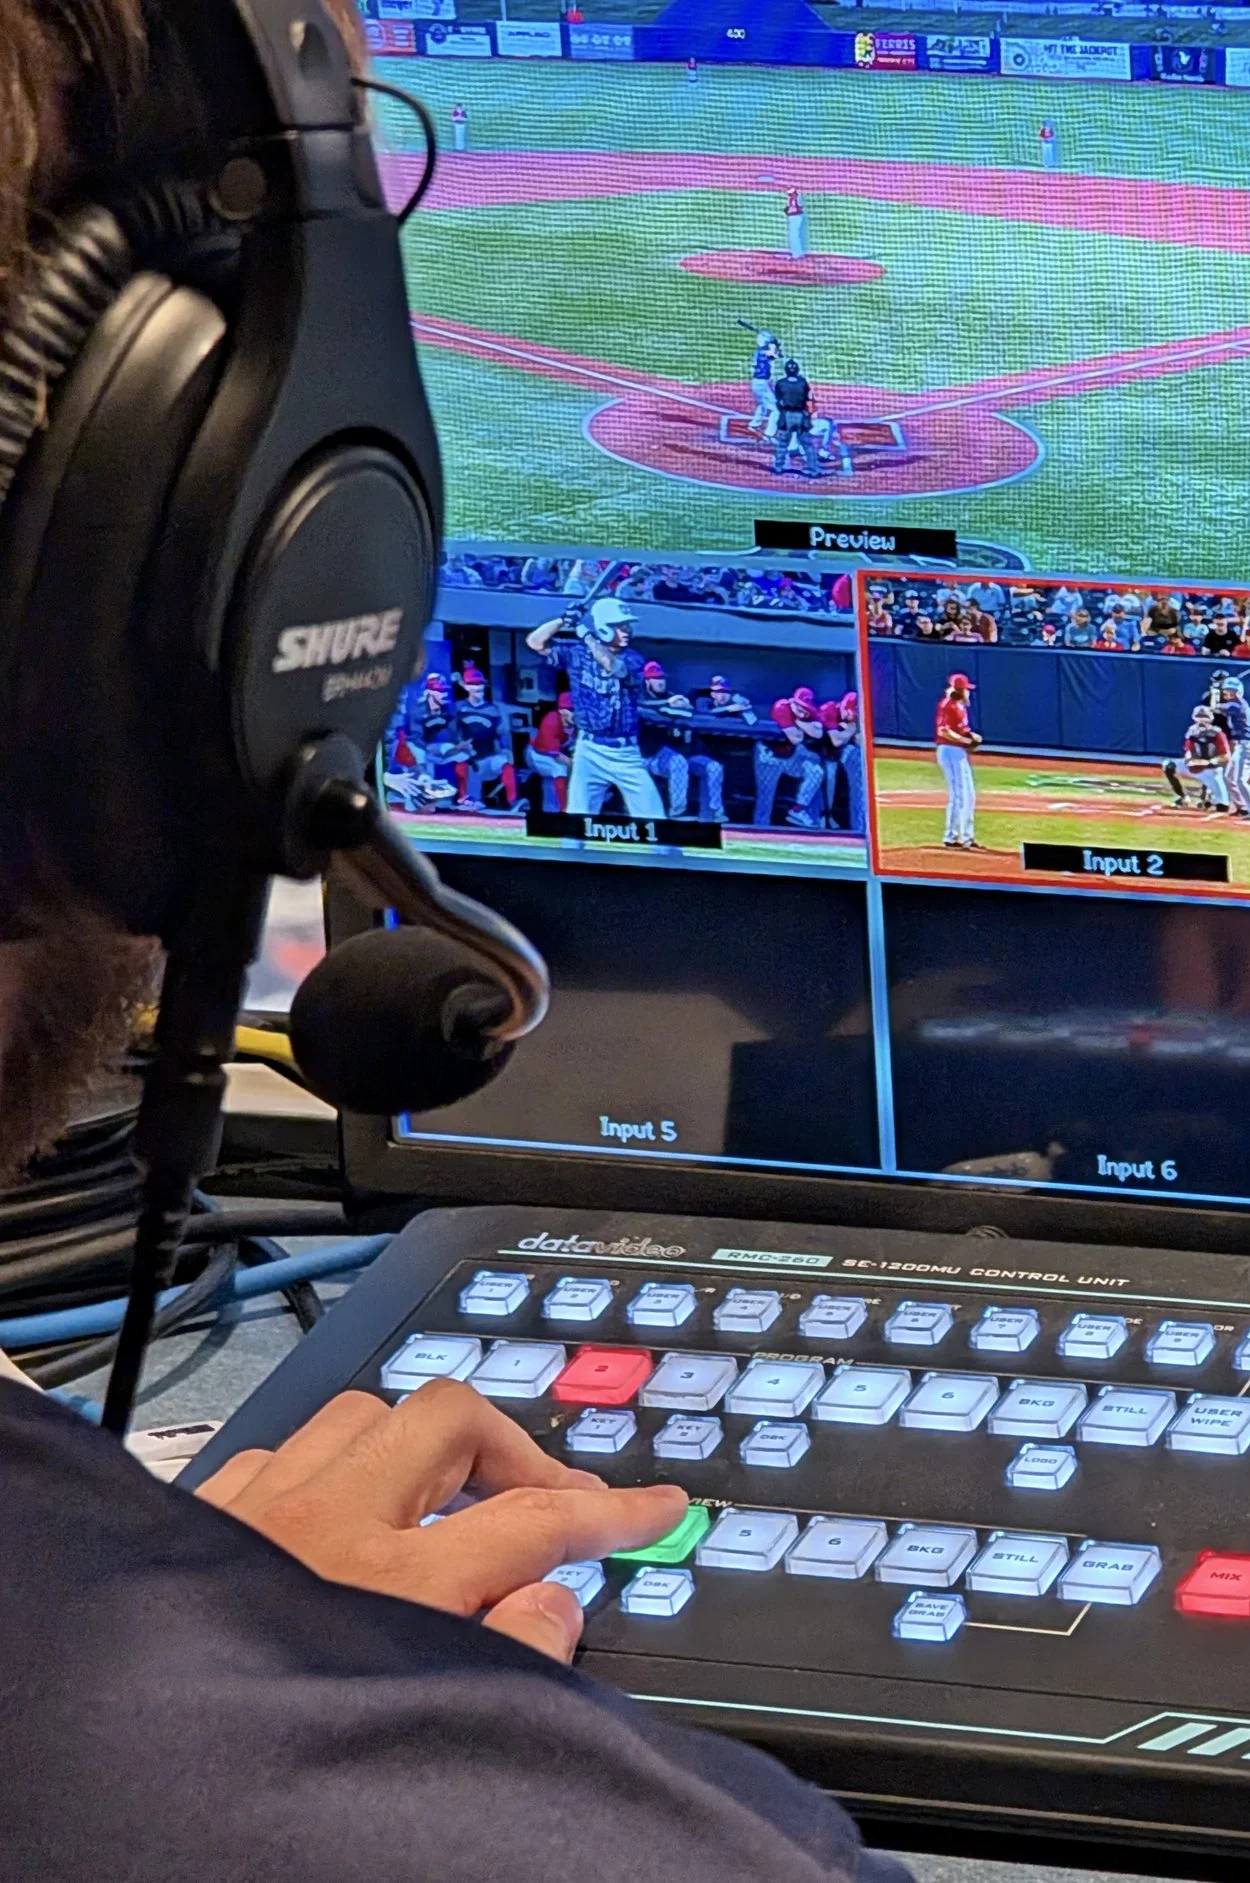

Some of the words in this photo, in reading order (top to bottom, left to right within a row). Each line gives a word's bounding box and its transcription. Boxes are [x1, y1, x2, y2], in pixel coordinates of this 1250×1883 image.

[809, 526, 896, 551] Preview
[272, 606, 404, 673] SHURE
[583, 817, 641, 844] Input
[645, 822, 658, 842] 1
[1082, 849, 1141, 877] Input
[1146, 854, 1165, 876] 2
[599, 1115, 656, 1143] Input
[661, 1121, 678, 1142] 5
[1097, 1153, 1156, 1182] Input
[1160, 1160, 1178, 1181] 6
[517, 1231, 687, 1258] datavideo
[726, 1249, 820, 1265] RMC-260
[841, 1258, 962, 1275] SE-1200MU
[969, 1266, 1071, 1283] CONTROL
[1077, 1275, 1131, 1287] UNIT
[414, 1351, 449, 1361] BLK
[751, 1352, 856, 1366] PROGRAM
[513, 1359, 522, 1367] 1
[679, 1371, 695, 1380] 3
[765, 1378, 781, 1386] 4
[853, 1384, 868, 1393] 5
[941, 1391, 955, 1400] 6
[1017, 1398, 1056, 1408] BKG
[1101, 1404, 1149, 1415] STILL
[590, 1416, 617, 1425] KEY
[1190, 1416, 1234, 1427] WIPE
[676, 1423, 703, 1432] KEY
[1023, 1456, 1059, 1465] LOGO
[828, 1537, 842, 1546] 6
[907, 1544, 945, 1555] BKG
[991, 1551, 1040, 1564] STILL
[1081, 1560, 1134, 1571] GRAB
[556, 1570, 585, 1578] KEY
[1209, 1570, 1243, 1582] MIX
[914, 1602, 950, 1610] SAVE
[908, 1609, 946, 1618] GRAB
